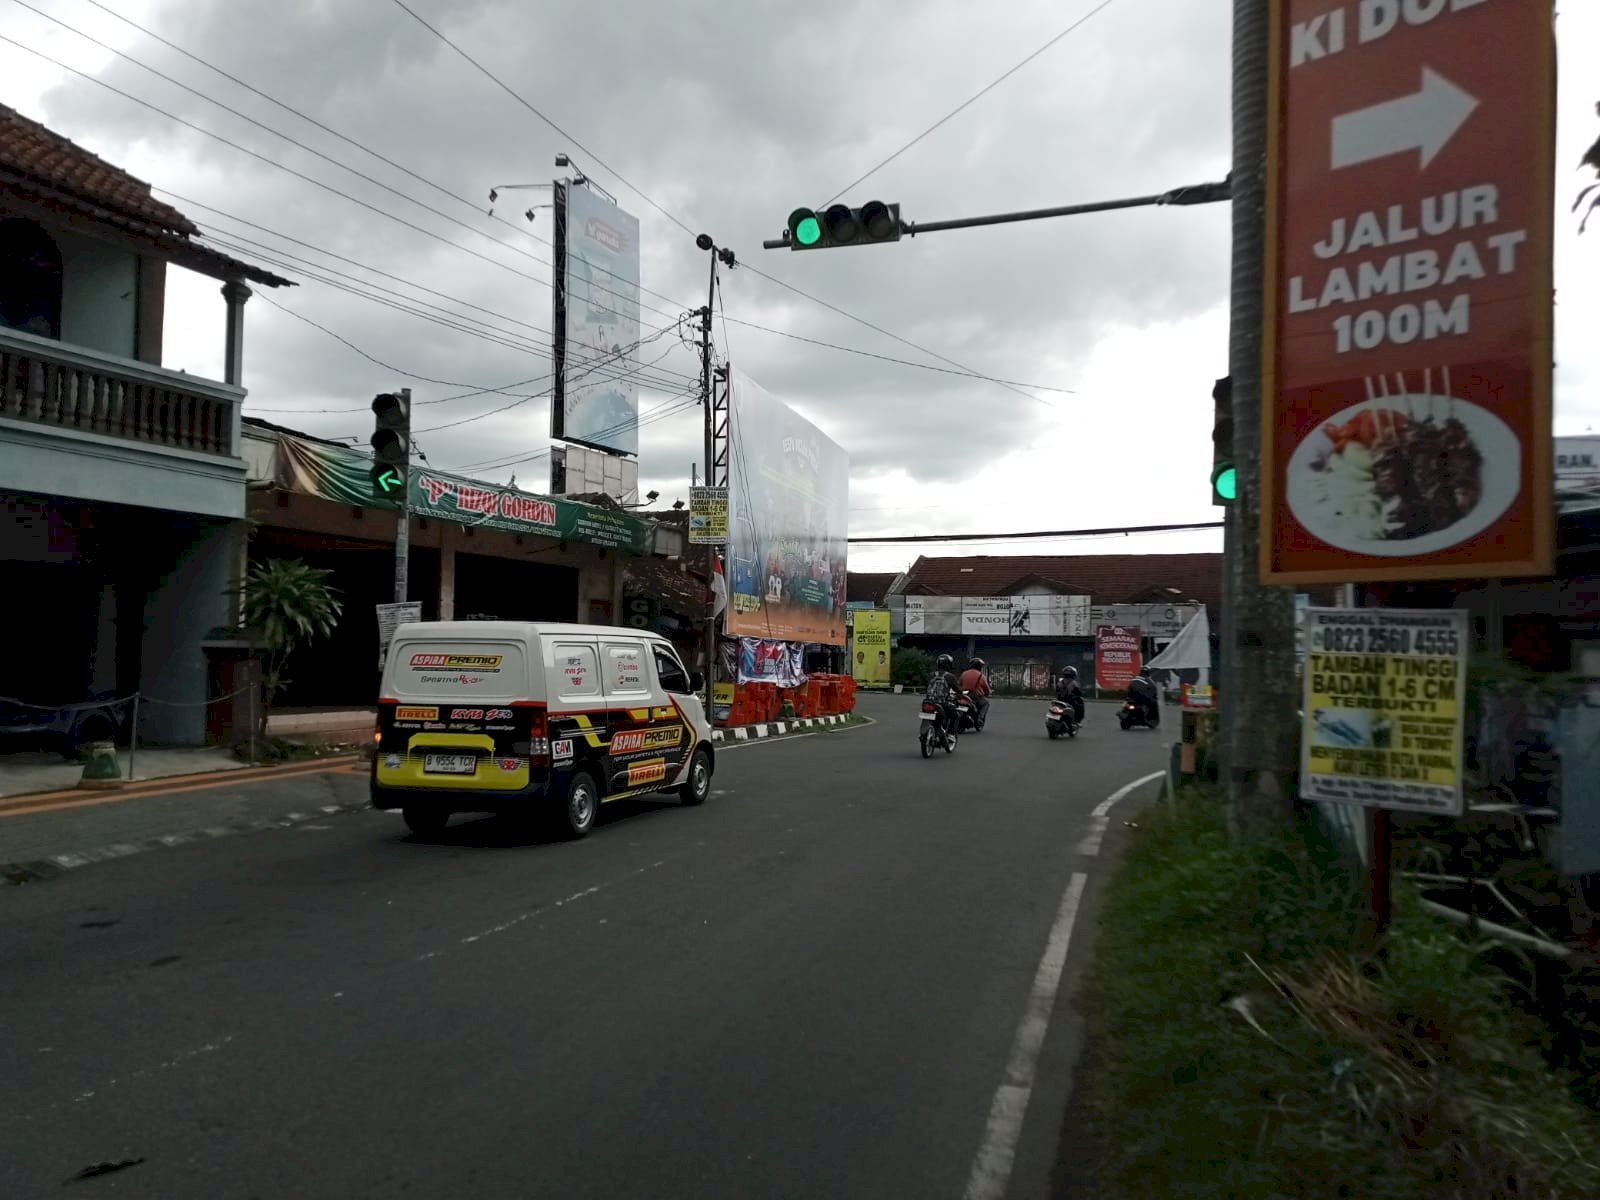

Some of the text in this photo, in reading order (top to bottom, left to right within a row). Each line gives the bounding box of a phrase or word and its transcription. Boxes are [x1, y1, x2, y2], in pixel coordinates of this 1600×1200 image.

[1290, 0, 1488, 67] KI DO
[1313, 184, 1498, 260] JALUR
[1288, 229, 1527, 314] LAMBAT
[1334, 294, 1469, 354] 100M
[501, 493, 556, 526] GORDEN
[966, 616, 1010, 624] HONDA
[1324, 627, 1458, 655] 0823 2560 4555
[411, 655, 498, 665] ASPIRA PREMIO
[1311, 655, 1458, 678] TAMBAH TINGGI
[1312, 674, 1381, 696] BADAN
[1423, 679, 1456, 700] CM
[450, 708, 484, 719] KYB
[1329, 696, 1437, 712] TERBUKTI
[612, 728, 680, 751] ASPIRA PREMIO
[629, 765, 665, 783] PIRELLI
